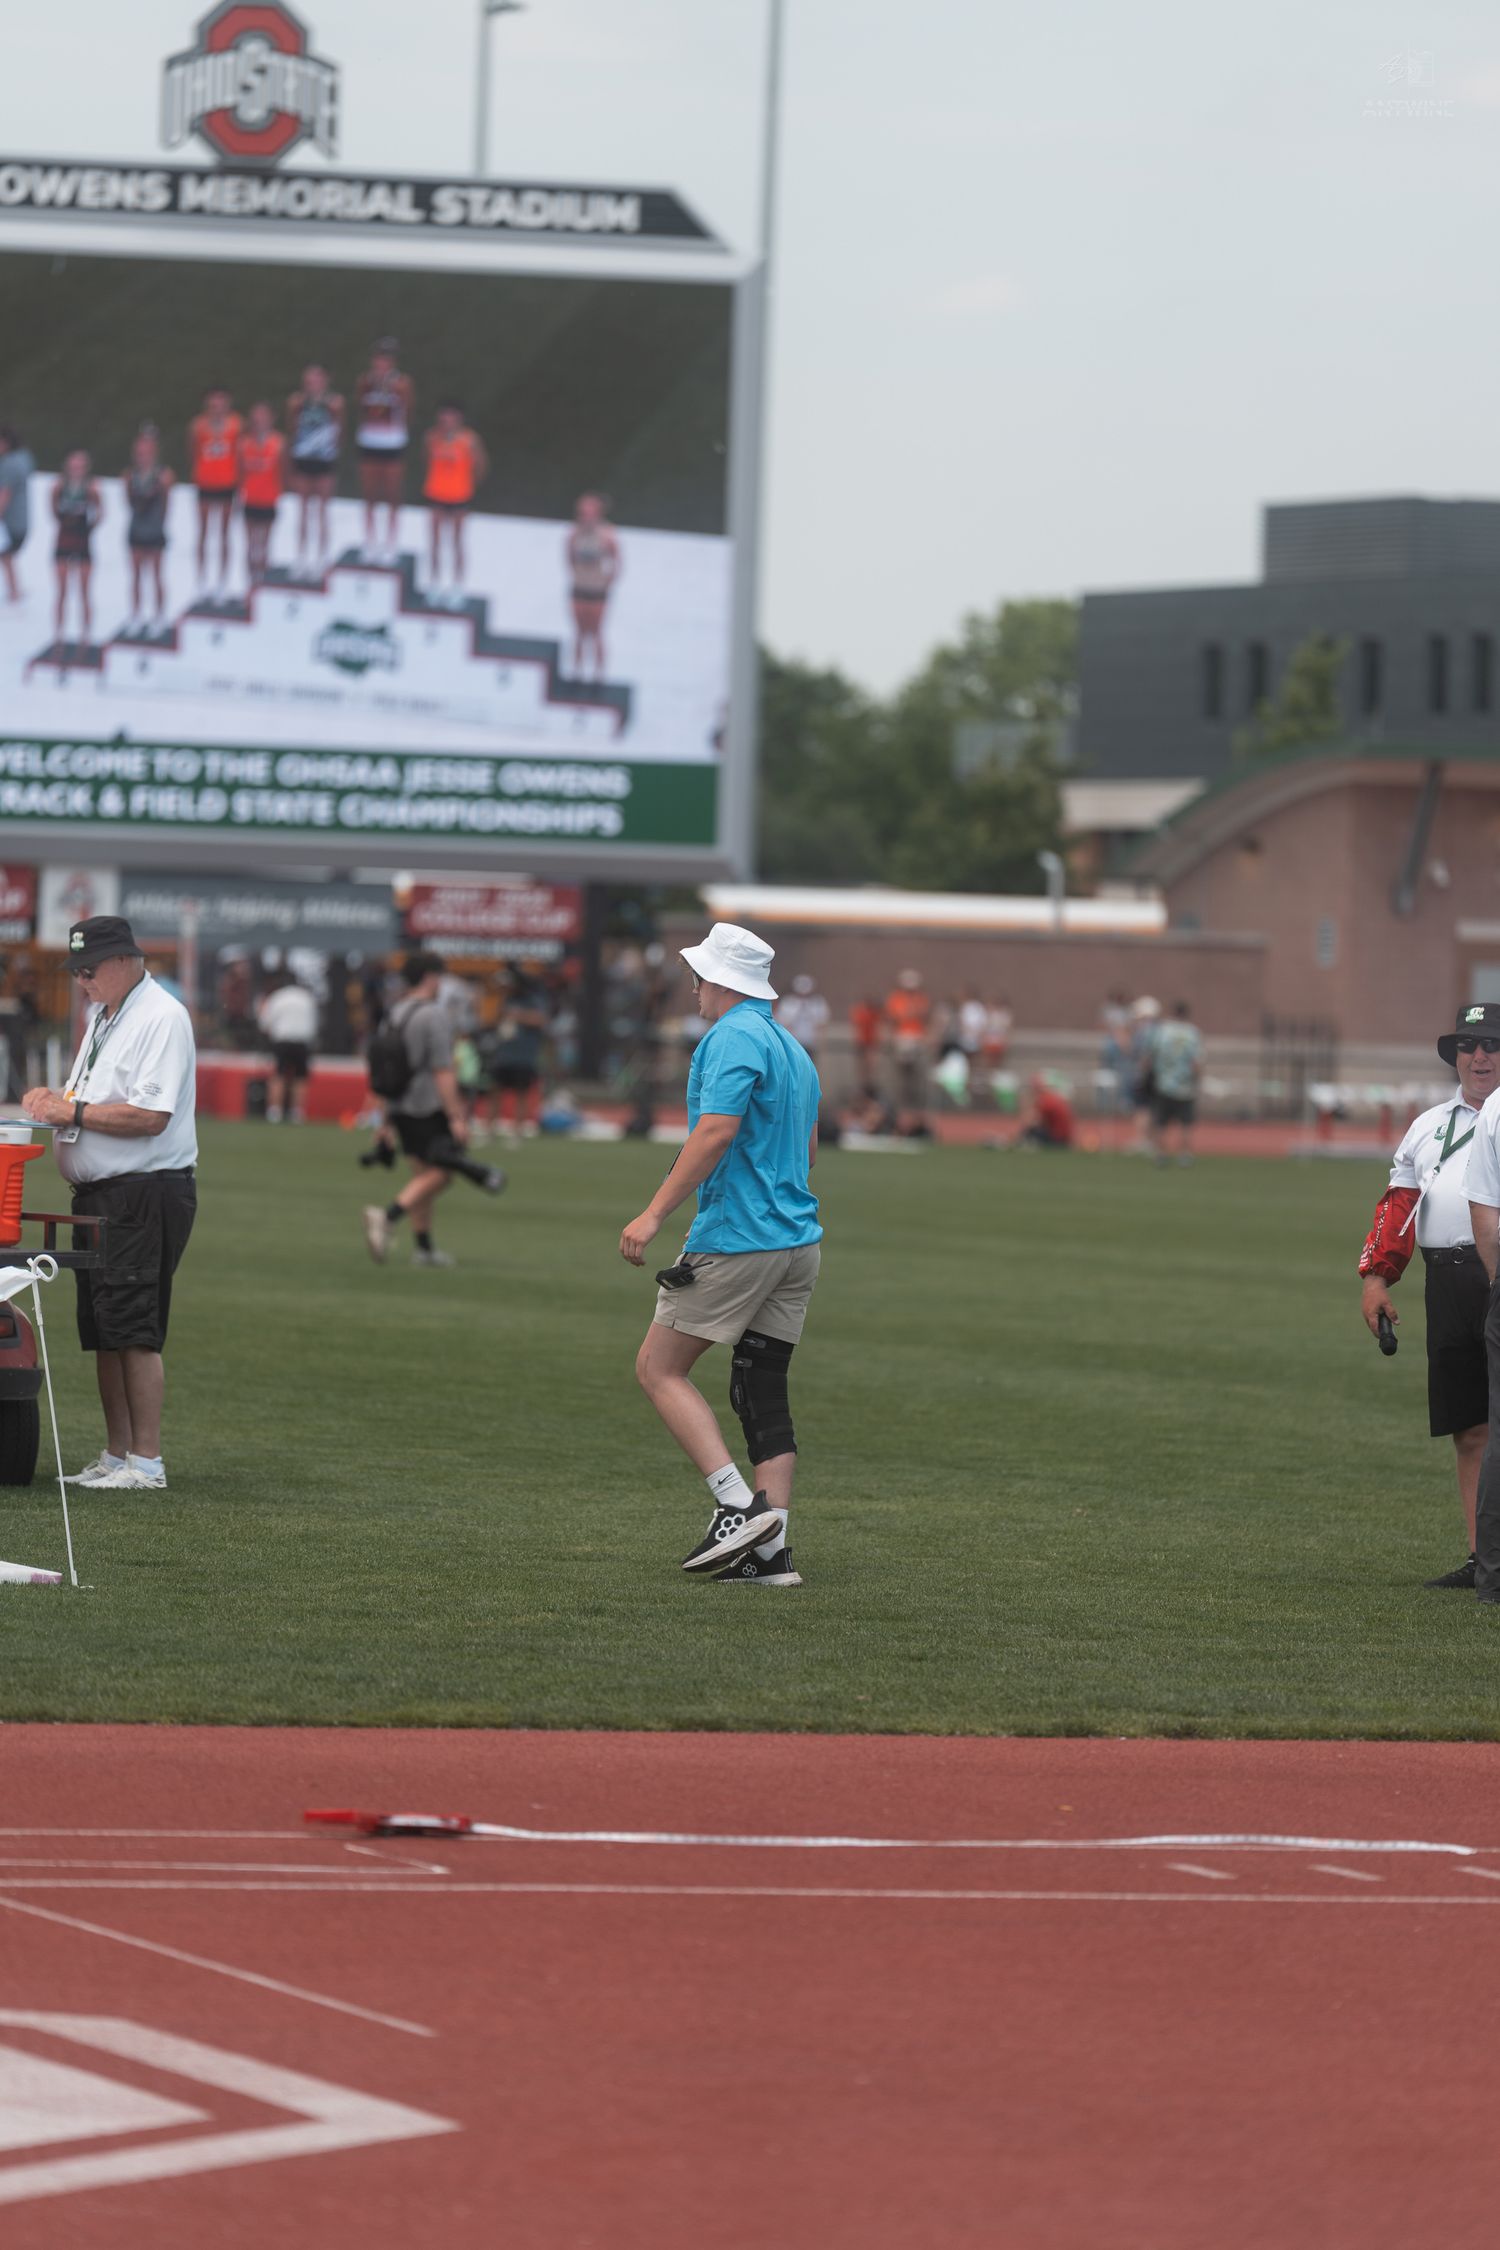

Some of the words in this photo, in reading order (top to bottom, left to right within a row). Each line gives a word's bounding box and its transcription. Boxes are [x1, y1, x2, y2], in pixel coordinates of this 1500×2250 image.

[0, 164, 172, 212] OWENS
[178, 172, 426, 225] MEMORIAL
[430, 184, 643, 233] STADIUM
[152, 747, 201, 784] TO
[204, 751, 273, 786] THE
[401, 757, 496, 797] JESSE
[497, 761, 632, 800] OWENS
[0, 780, 93, 817] RACK
[97, 782, 126, 819] &
[129, 784, 229, 823] FIELD
[230, 787, 337, 827] STATE
[338, 791, 625, 838] CHAMPIONSHIPS
